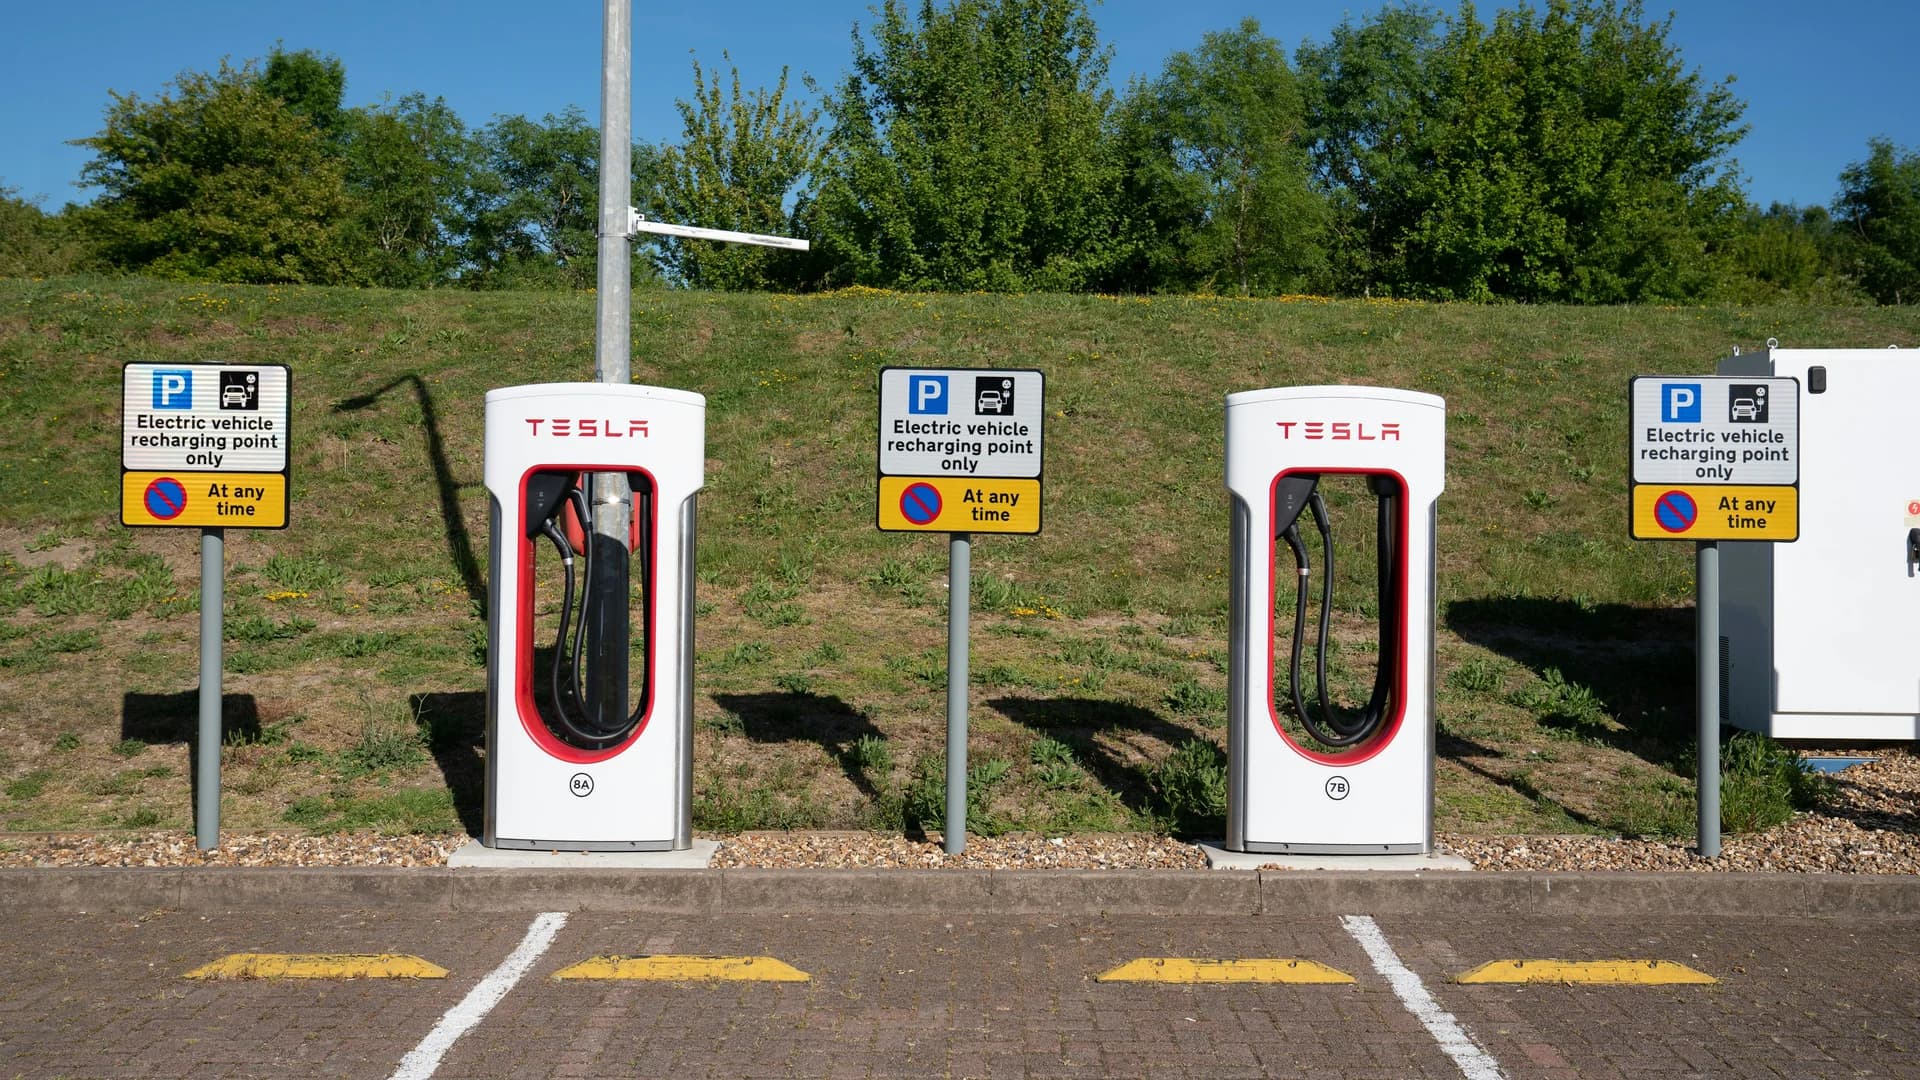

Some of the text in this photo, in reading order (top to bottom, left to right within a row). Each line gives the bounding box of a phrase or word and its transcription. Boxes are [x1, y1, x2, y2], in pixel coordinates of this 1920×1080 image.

[162, 375, 185, 405] P
[918, 380, 942, 411] P
[1671, 388, 1694, 419] P
[137, 414, 273, 430] Electric vehicle
[525, 419, 649, 438] TESLA
[894, 420, 1029, 436] Electric vehicle
[1276, 422, 1400, 441] TESLA
[1647, 428, 1784, 443] Electric vehicle
[132, 433, 278, 450] recharging point
[888, 438, 1033, 456] recharging point
[186, 451, 223, 468] only
[1641, 446, 1789, 463] recharging point
[941, 456, 978, 473] only
[1695, 464, 1733, 481] only
[208, 484, 265, 501] At any
[963, 489, 1020, 507] At any
[217, 502, 256, 516] time
[1718, 496, 1776, 514] At any
[972, 507, 1010, 521] time
[1727, 515, 1767, 529] time
[573, 779, 590, 790] 8A
[1329, 782, 1346, 793] 7B
